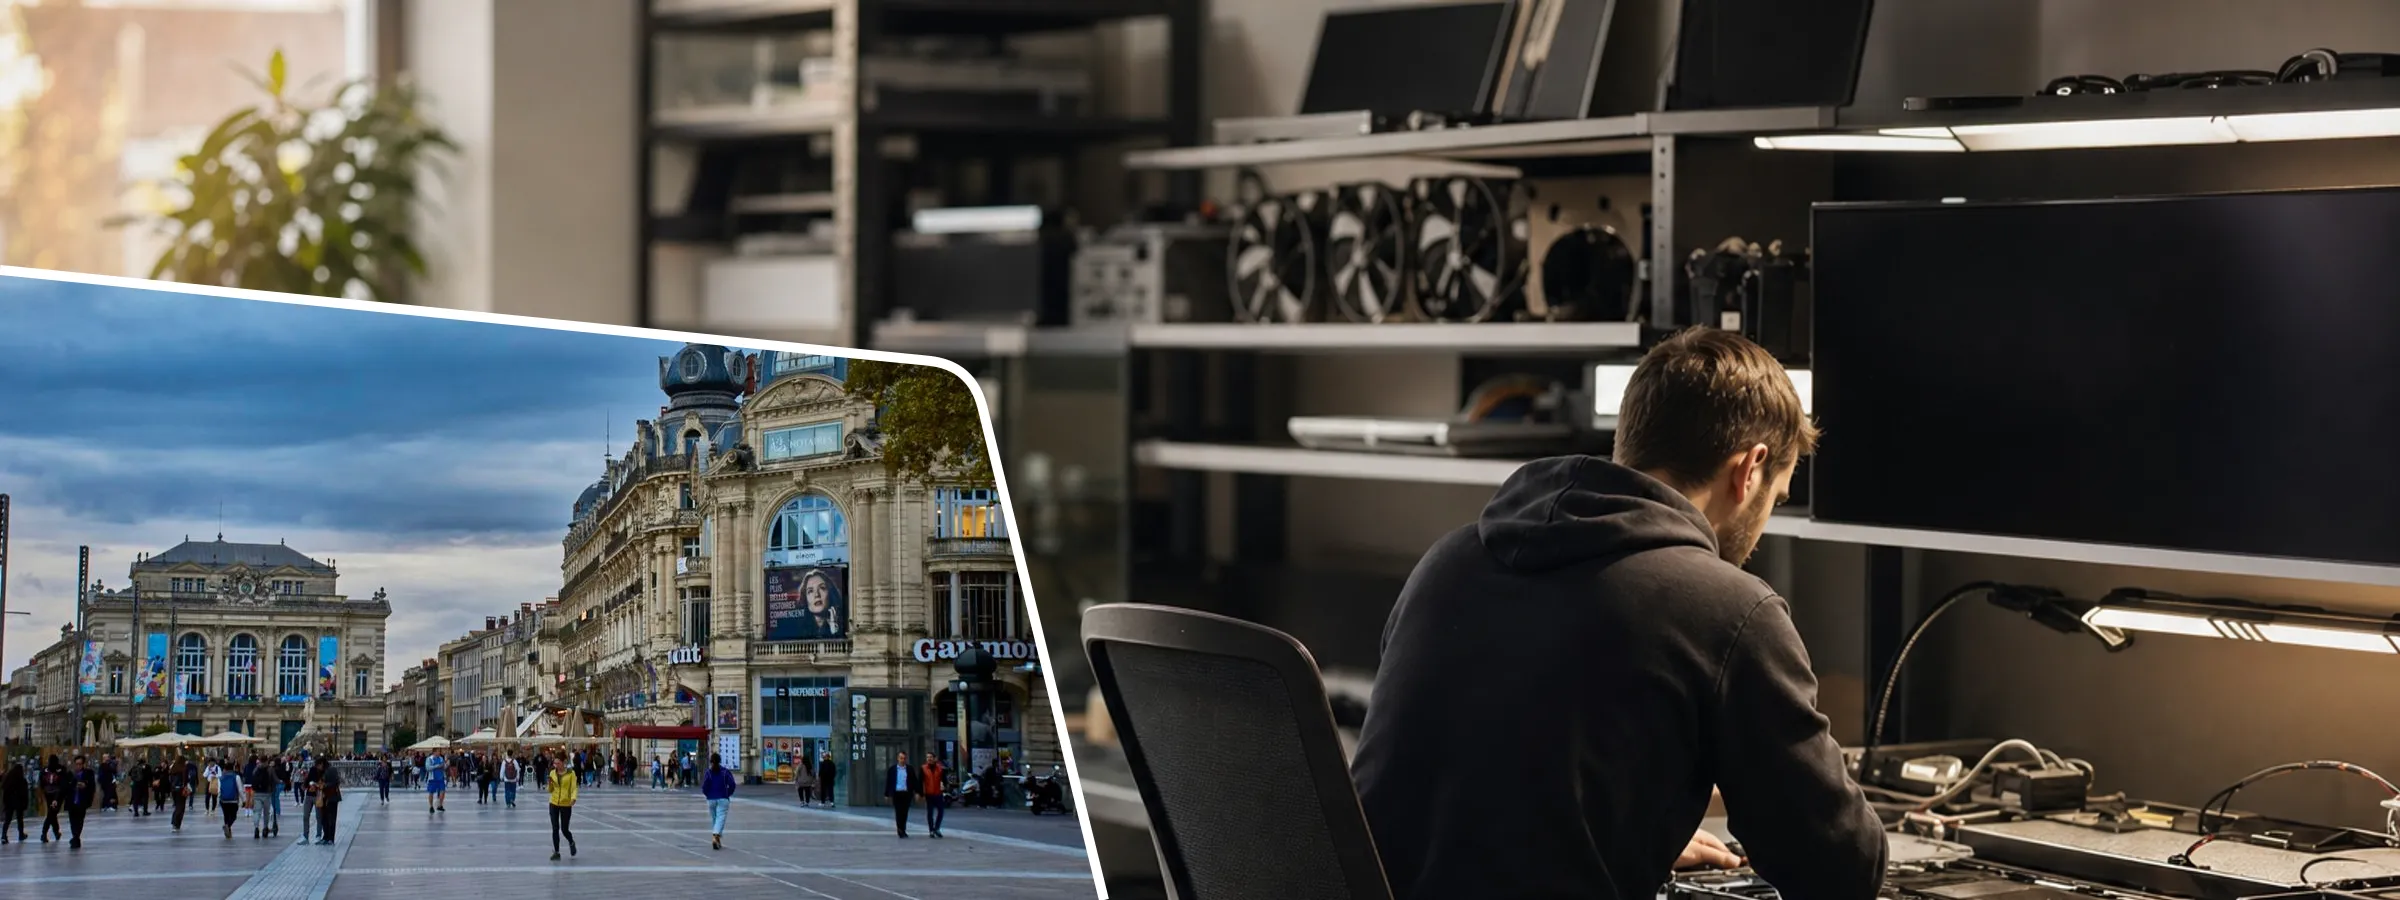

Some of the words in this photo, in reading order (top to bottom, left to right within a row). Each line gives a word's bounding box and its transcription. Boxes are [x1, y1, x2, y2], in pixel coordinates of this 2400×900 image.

[769, 576, 779, 584] LES
[769, 584, 783, 593] PLUS
[769, 593, 788, 602] BELLES
[769, 601, 796, 610] HISTOIRES
[769, 609, 805, 619] COMMENCENT
[769, 619, 778, 628] ICI
[667, 642, 702, 665] ont
